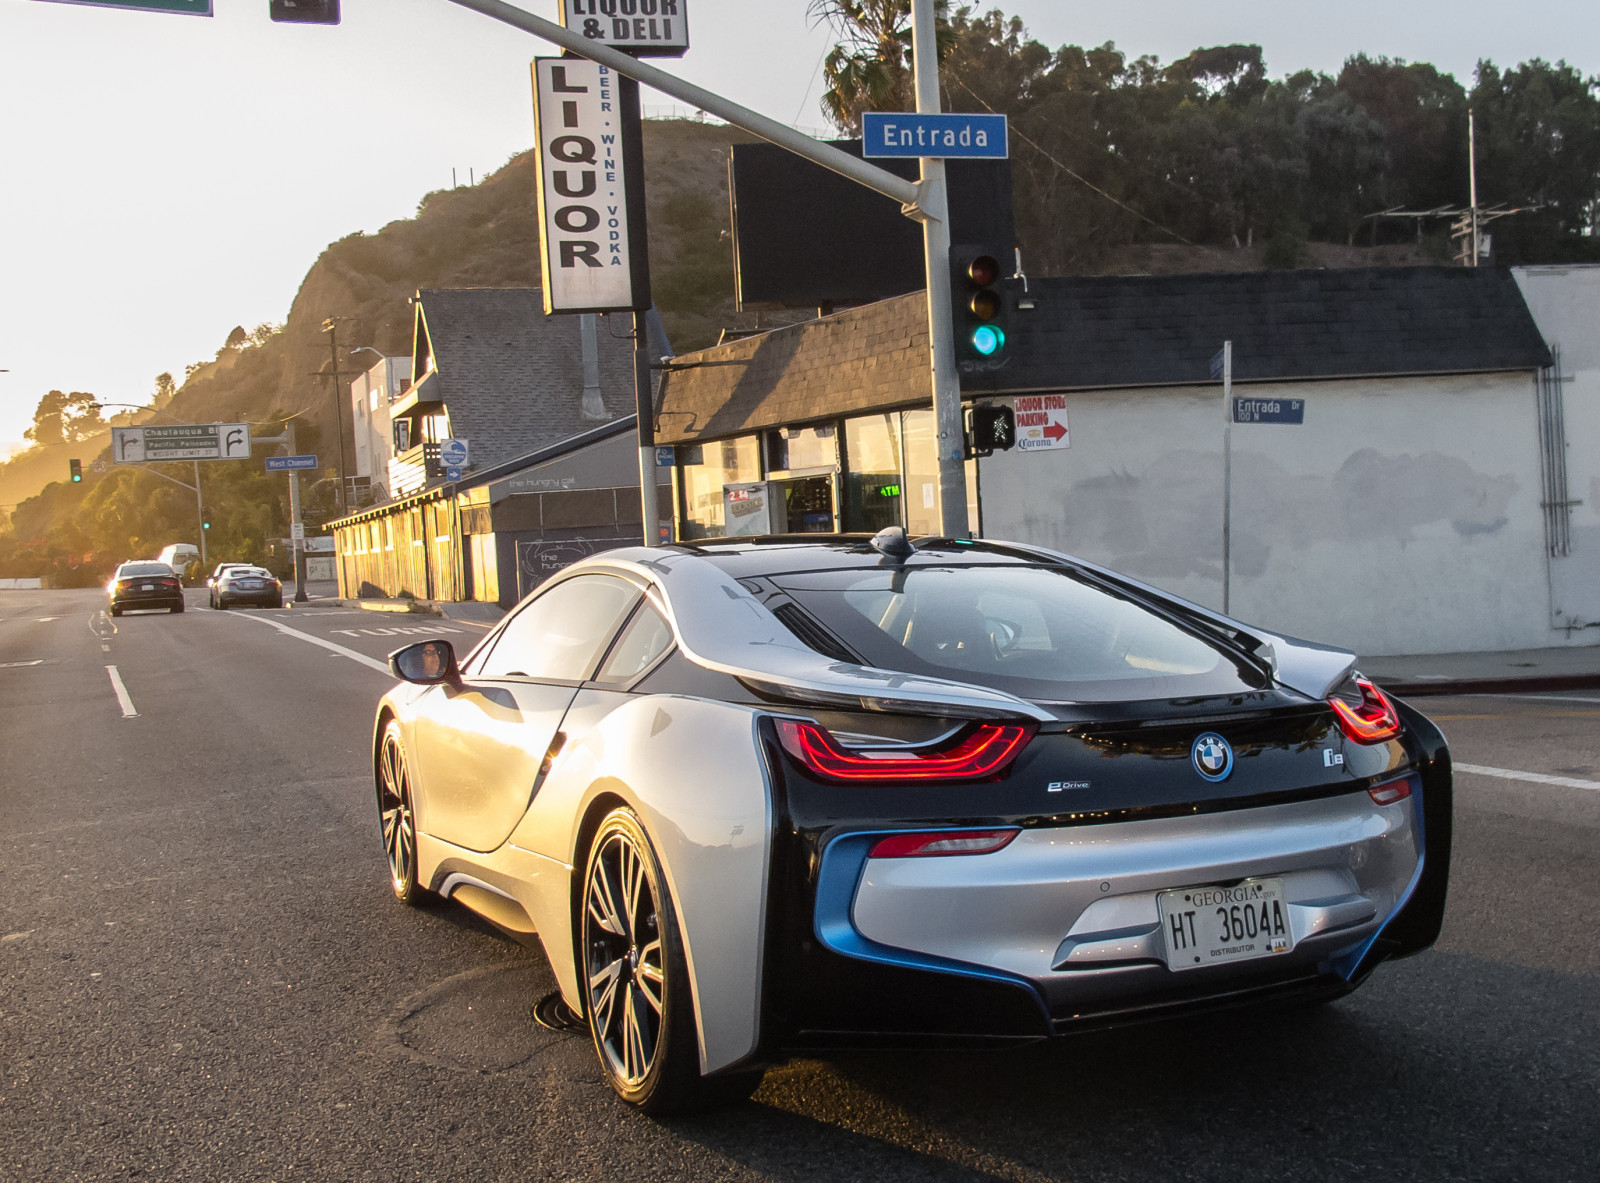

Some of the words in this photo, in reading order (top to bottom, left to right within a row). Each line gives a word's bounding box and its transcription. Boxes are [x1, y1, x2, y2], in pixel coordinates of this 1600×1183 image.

[573, 0, 677, 17] LIQUOR
[583, 18, 605, 39] &
[612, 18, 672, 40] DELI
[599, 65, 612, 112] BEER
[883, 124, 988, 147] Entrada
[550, 65, 604, 267] LIQUOR
[601, 135, 616, 181] WINE
[607, 206, 621, 265] VODKA
[1015, 397, 1043, 412] LIQUOR
[1043, 395, 1066, 410] STORE
[1238, 399, 1280, 413] Entrada
[1291, 401, 1300, 410] Dr
[1016, 411, 1049, 427] PARKING
[1238, 412, 1251, 421] 100
[1253, 413, 1260, 421] N
[144, 428, 202, 437] Chautauqua
[1018, 438, 1051, 450] Corona
[269, 460, 285, 468] West
[287, 459, 314, 467] Channel
[526, 479, 559, 488] hungry
[880, 485, 900, 497] ATM
[541, 553, 558, 561] the
[329, 626, 464, 637] TURN
[1323, 748, 1344, 767] i8
[1170, 911, 1196, 950] HT
[1216, 900, 1286, 942] 3604A
[1210, 944, 1255, 957] DISTRIBUTOR
